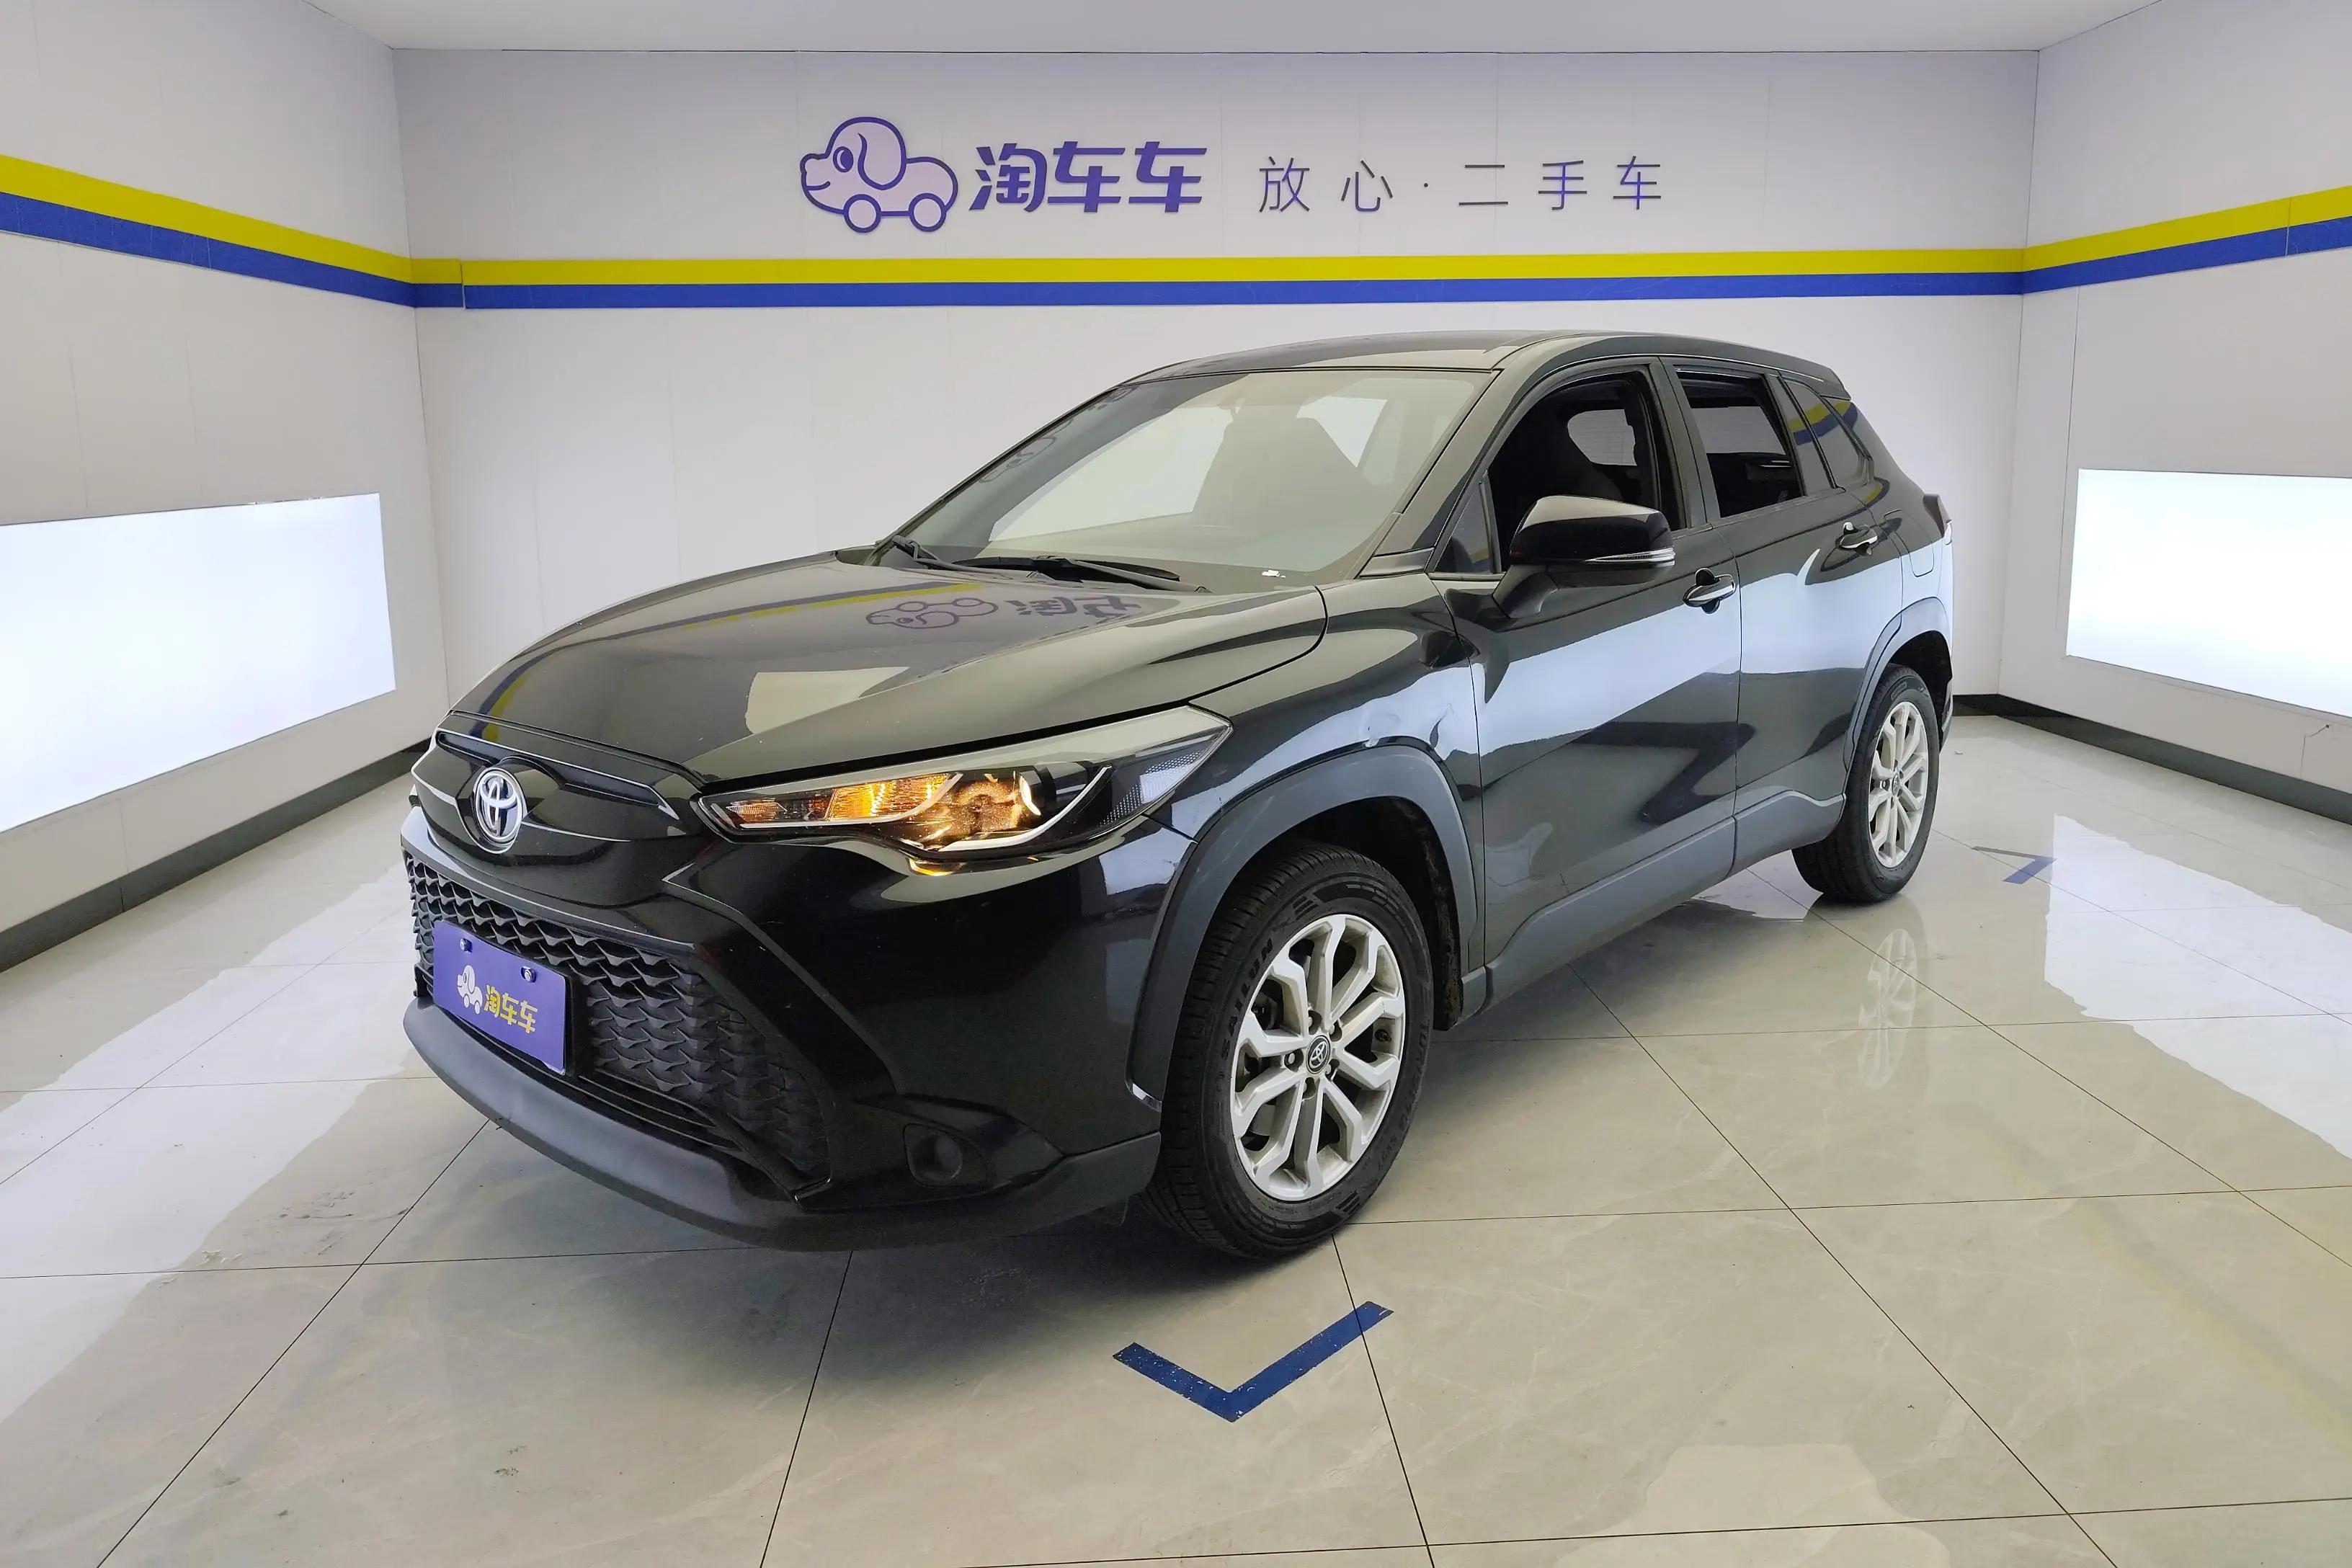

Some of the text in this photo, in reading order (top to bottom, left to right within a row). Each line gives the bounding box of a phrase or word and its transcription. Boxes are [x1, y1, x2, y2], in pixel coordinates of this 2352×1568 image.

[968, 141, 1208, 213] 淘车车
[484, 986, 538, 1033] 淘车车
[1221, 937, 1273, 1060] SAILUN
